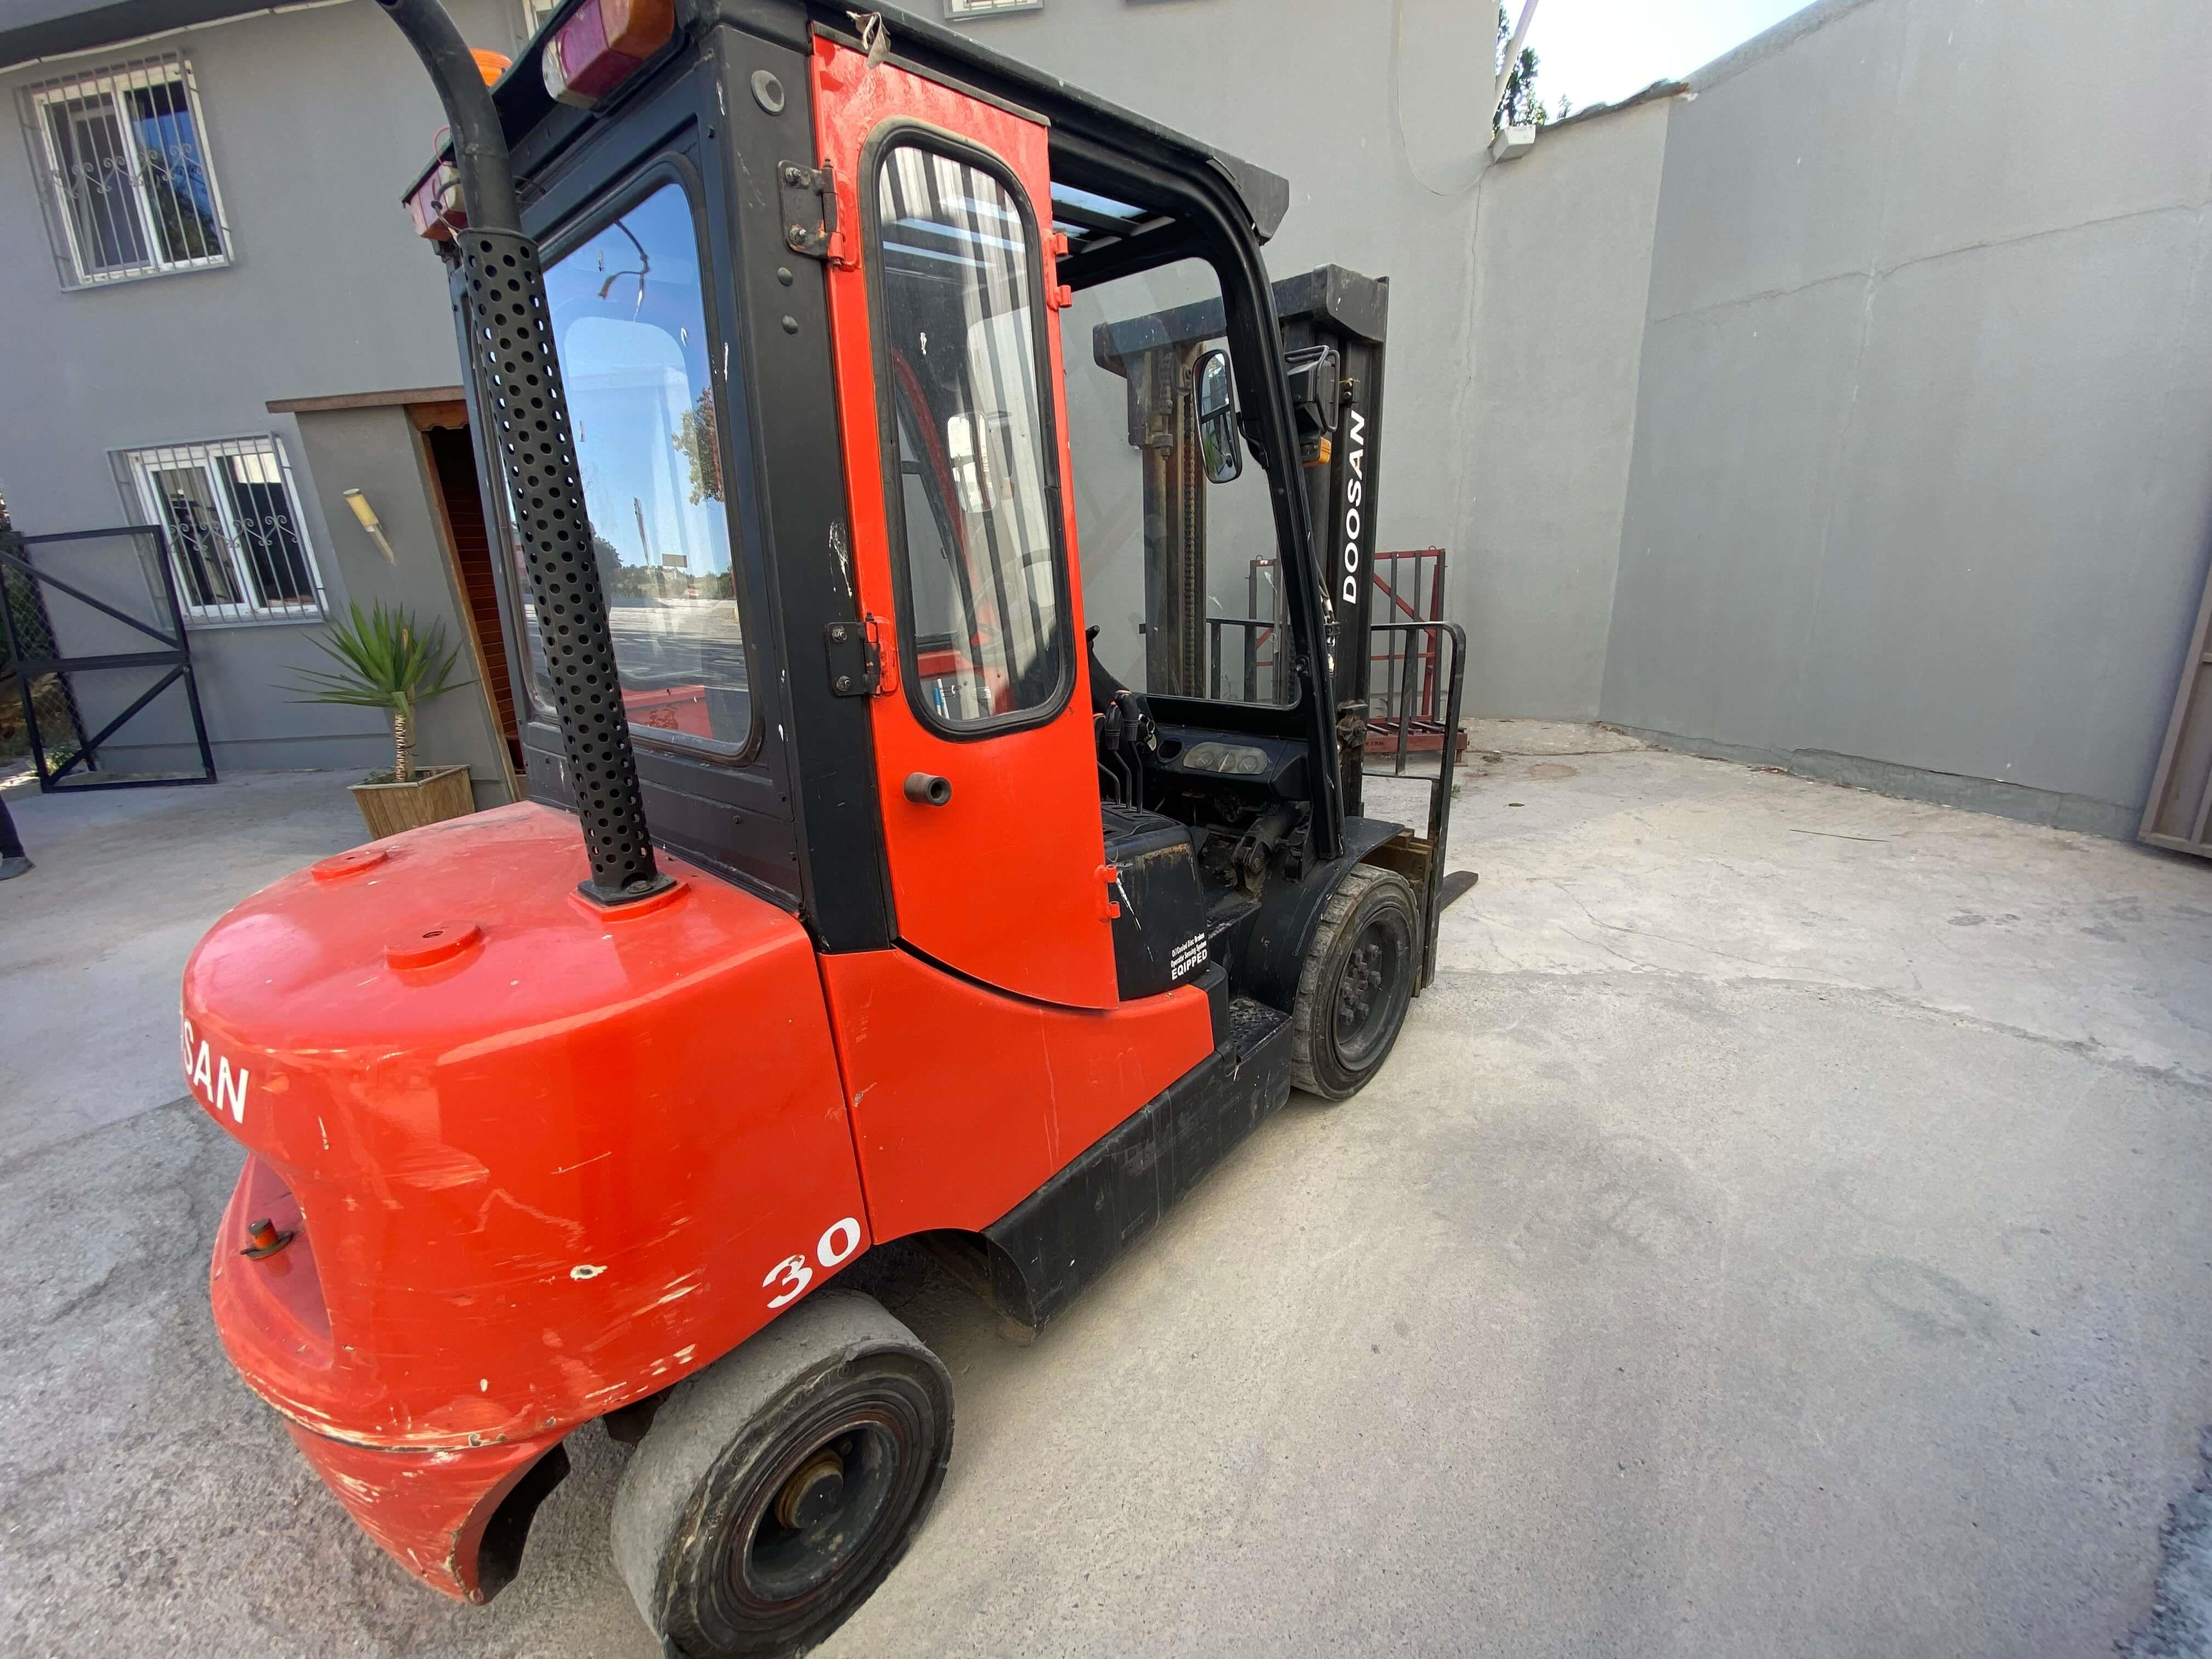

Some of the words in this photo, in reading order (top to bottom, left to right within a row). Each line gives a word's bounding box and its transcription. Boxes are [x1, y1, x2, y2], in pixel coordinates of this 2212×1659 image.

[1343, 410, 1365, 604] DOOSAN
[1171, 949, 1207, 980] EQIPPED
[1194, 932, 1205, 943] Brakes
[762, 1217, 861, 1309] 30
